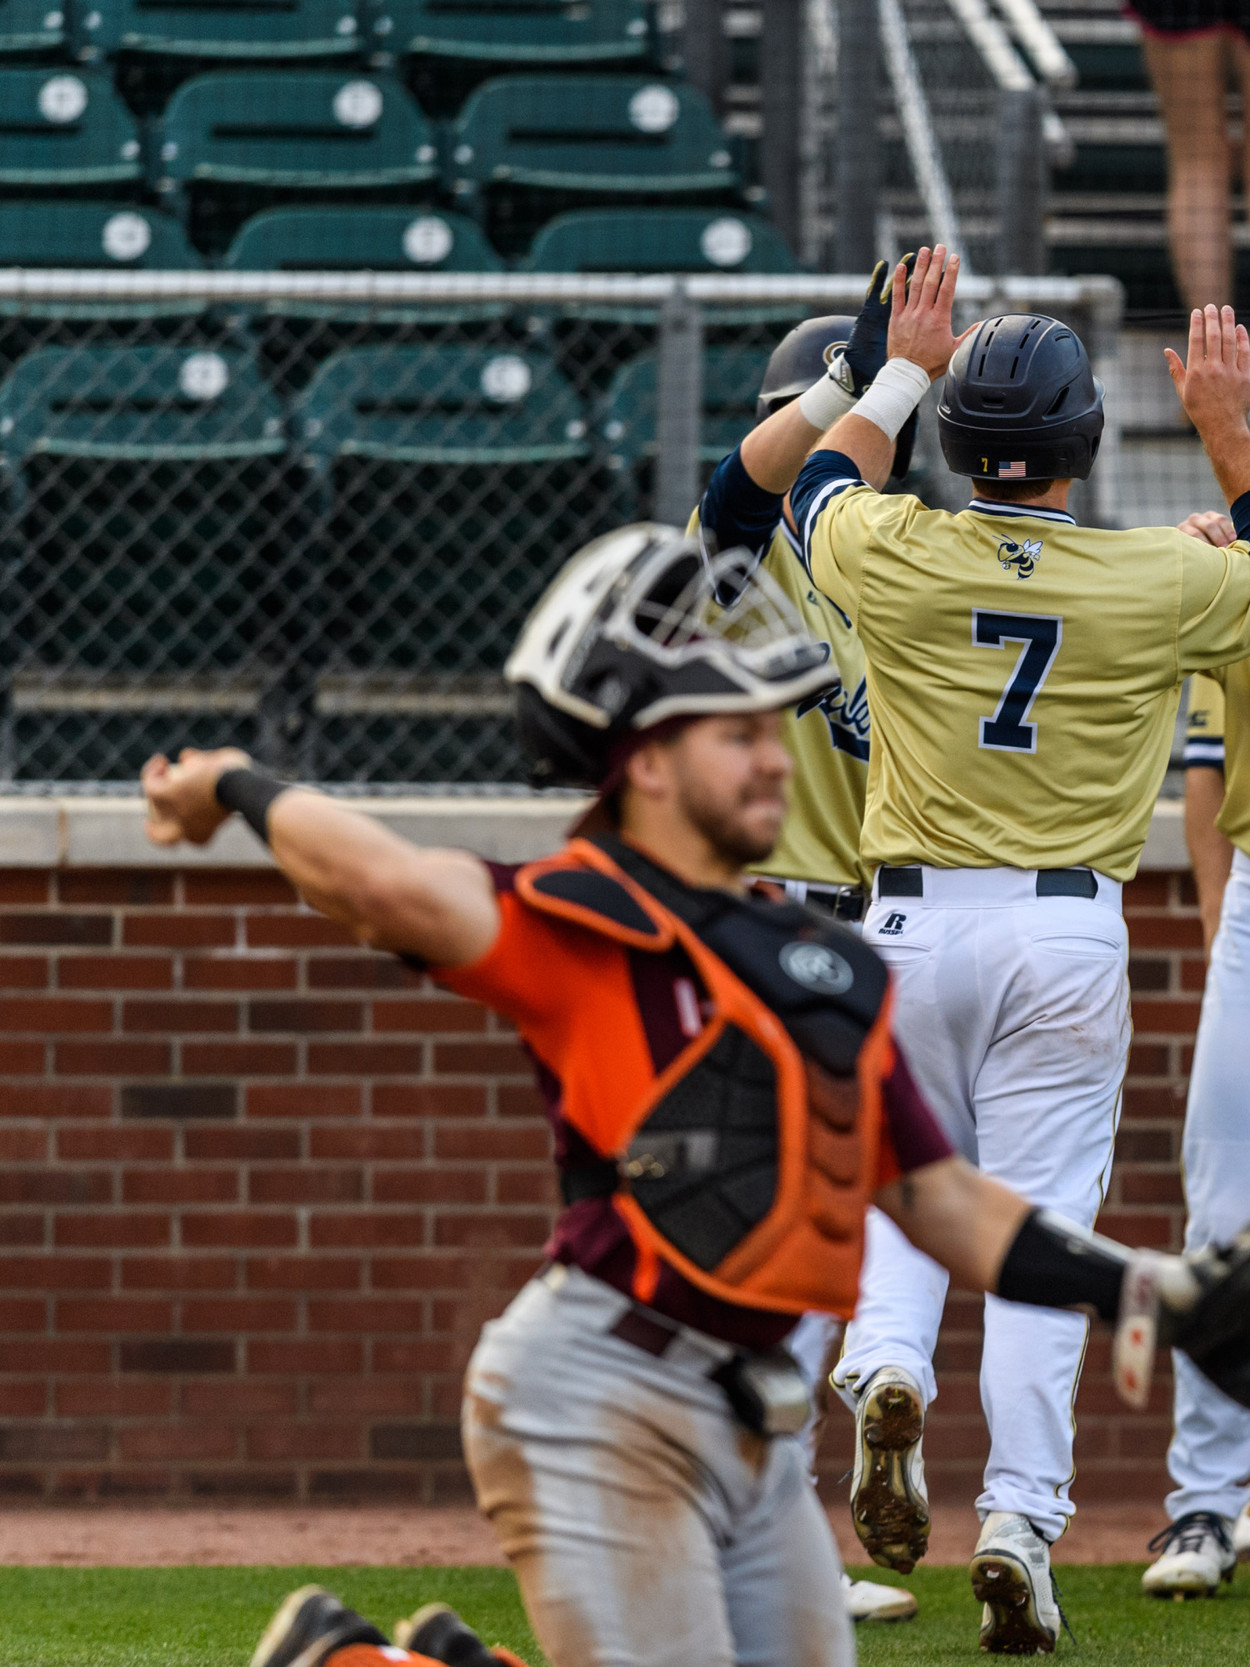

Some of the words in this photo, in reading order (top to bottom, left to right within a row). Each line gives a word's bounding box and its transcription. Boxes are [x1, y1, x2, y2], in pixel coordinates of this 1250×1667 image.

[981, 457, 988, 473] 7
[971, 607, 1063, 754] 7
[884, 912, 907, 931] R
